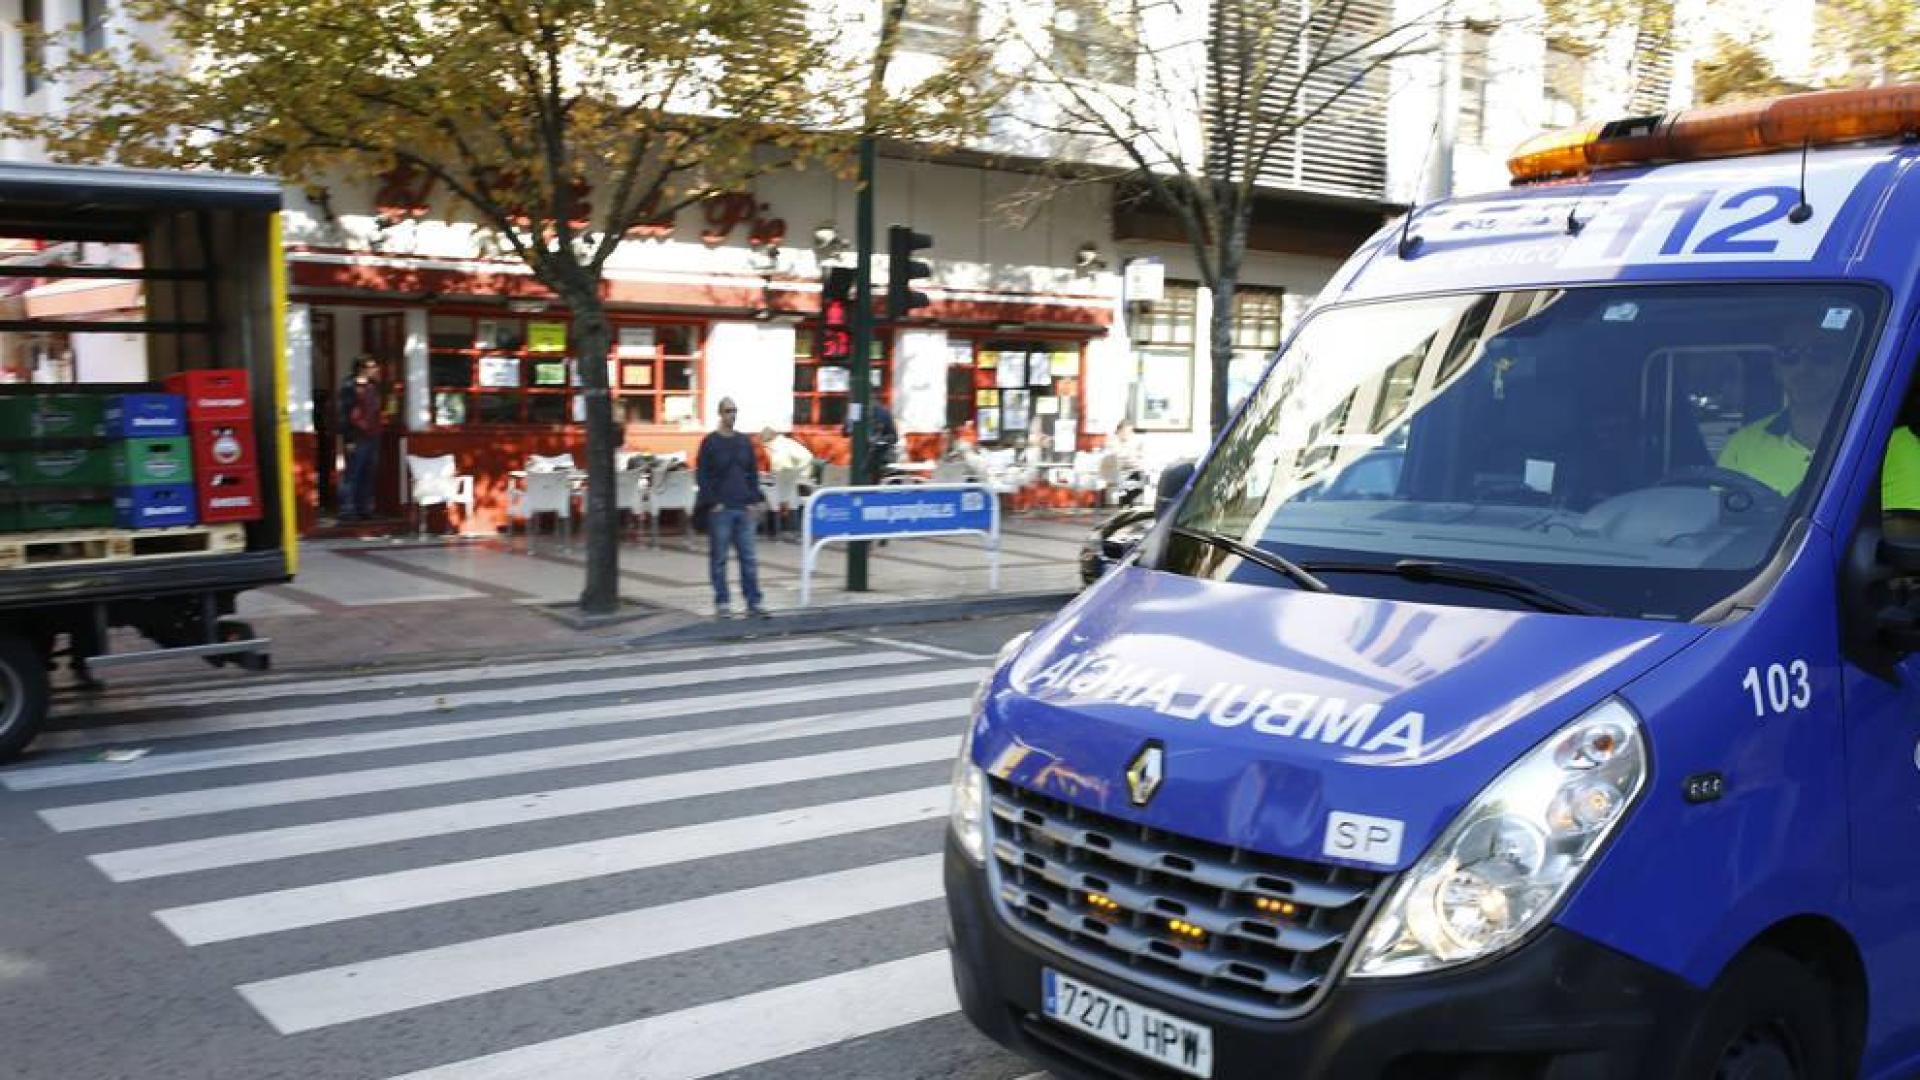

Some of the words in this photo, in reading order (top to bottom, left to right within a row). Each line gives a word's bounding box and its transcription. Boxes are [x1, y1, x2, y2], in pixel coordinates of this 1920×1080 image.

[1742, 659, 1811, 717] 103
[1333, 821, 1392, 852] SP
[1062, 981, 1130, 1041] 7270
[1143, 1015, 1199, 1068] HPW
